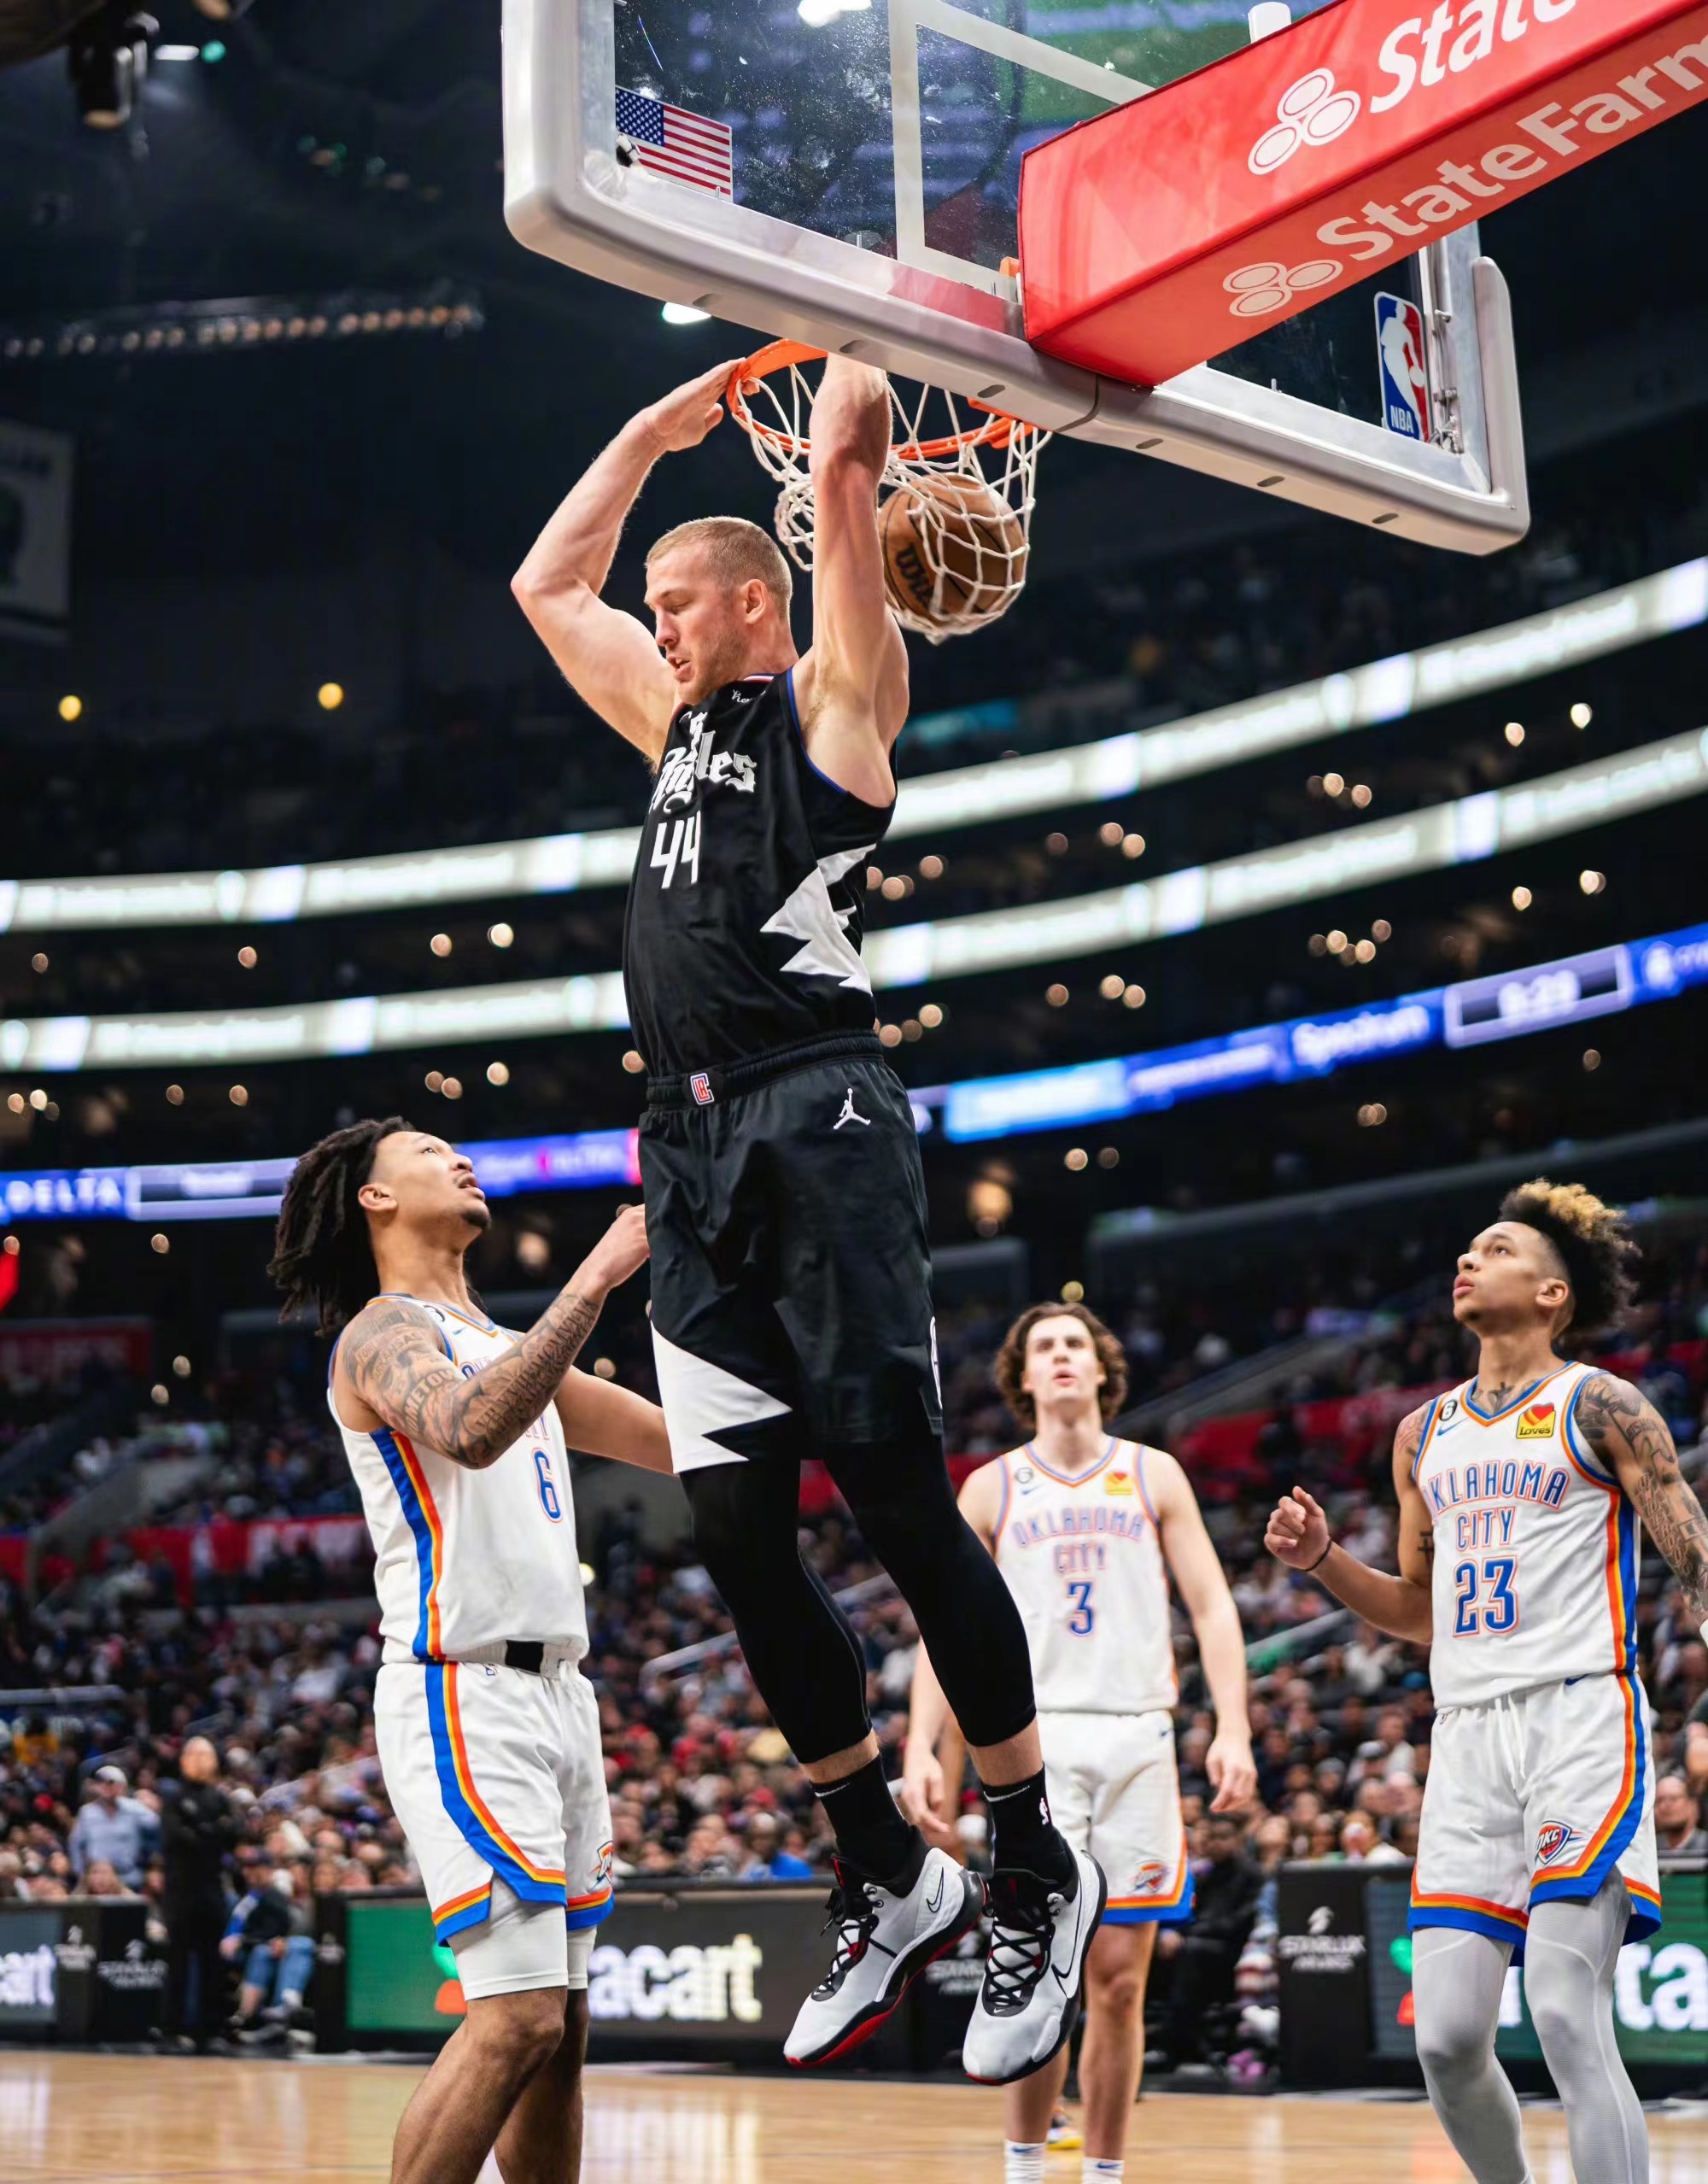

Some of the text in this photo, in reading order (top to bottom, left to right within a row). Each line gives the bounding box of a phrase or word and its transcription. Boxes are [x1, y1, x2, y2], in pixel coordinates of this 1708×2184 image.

[1370, 0, 1576, 114] Sta
[1389, 404, 1414, 434] NBA
[650, 811, 701, 890] 44
[7, 1177, 121, 1214] DELTA
[531, 1447, 564, 1523] 6
[1012, 1506, 1145, 1549] OKLAHOMA
[1455, 1506, 1516, 1552] CITY
[1066, 1578, 1096, 1637] 3
[1453, 1555, 1519, 1637] 23
[0, 1943, 56, 2006] art
